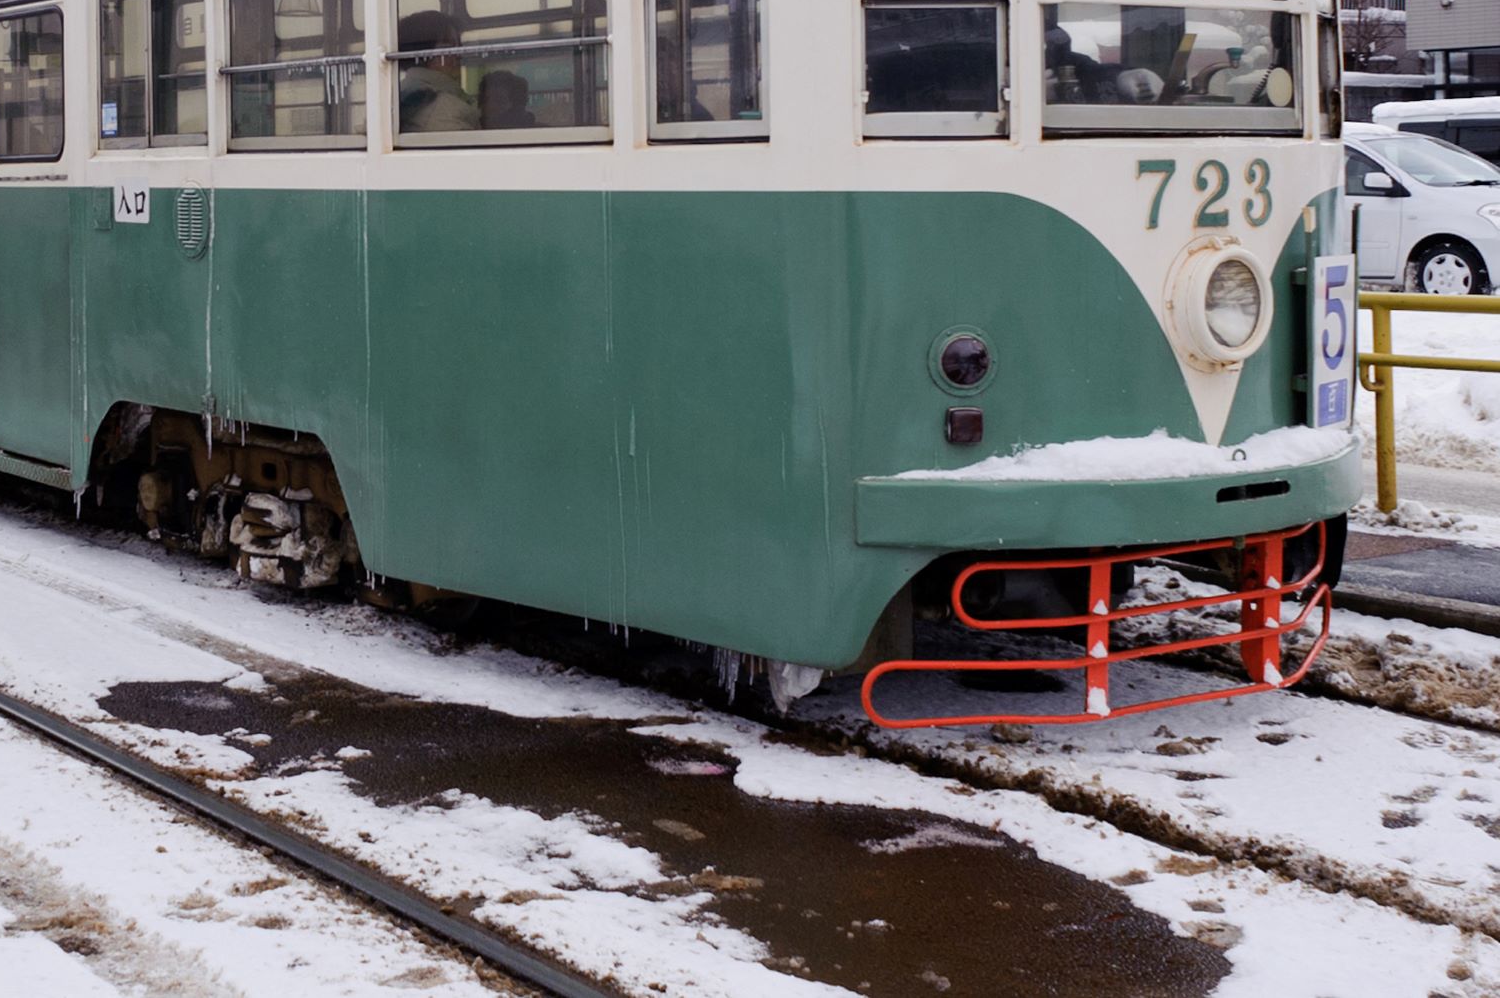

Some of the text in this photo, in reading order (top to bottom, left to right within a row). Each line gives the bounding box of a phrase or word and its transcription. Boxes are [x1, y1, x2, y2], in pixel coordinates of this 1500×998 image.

[117, 185, 147, 217] 入口
[1135, 157, 1274, 231] 723
[1321, 264, 1349, 371] 5
